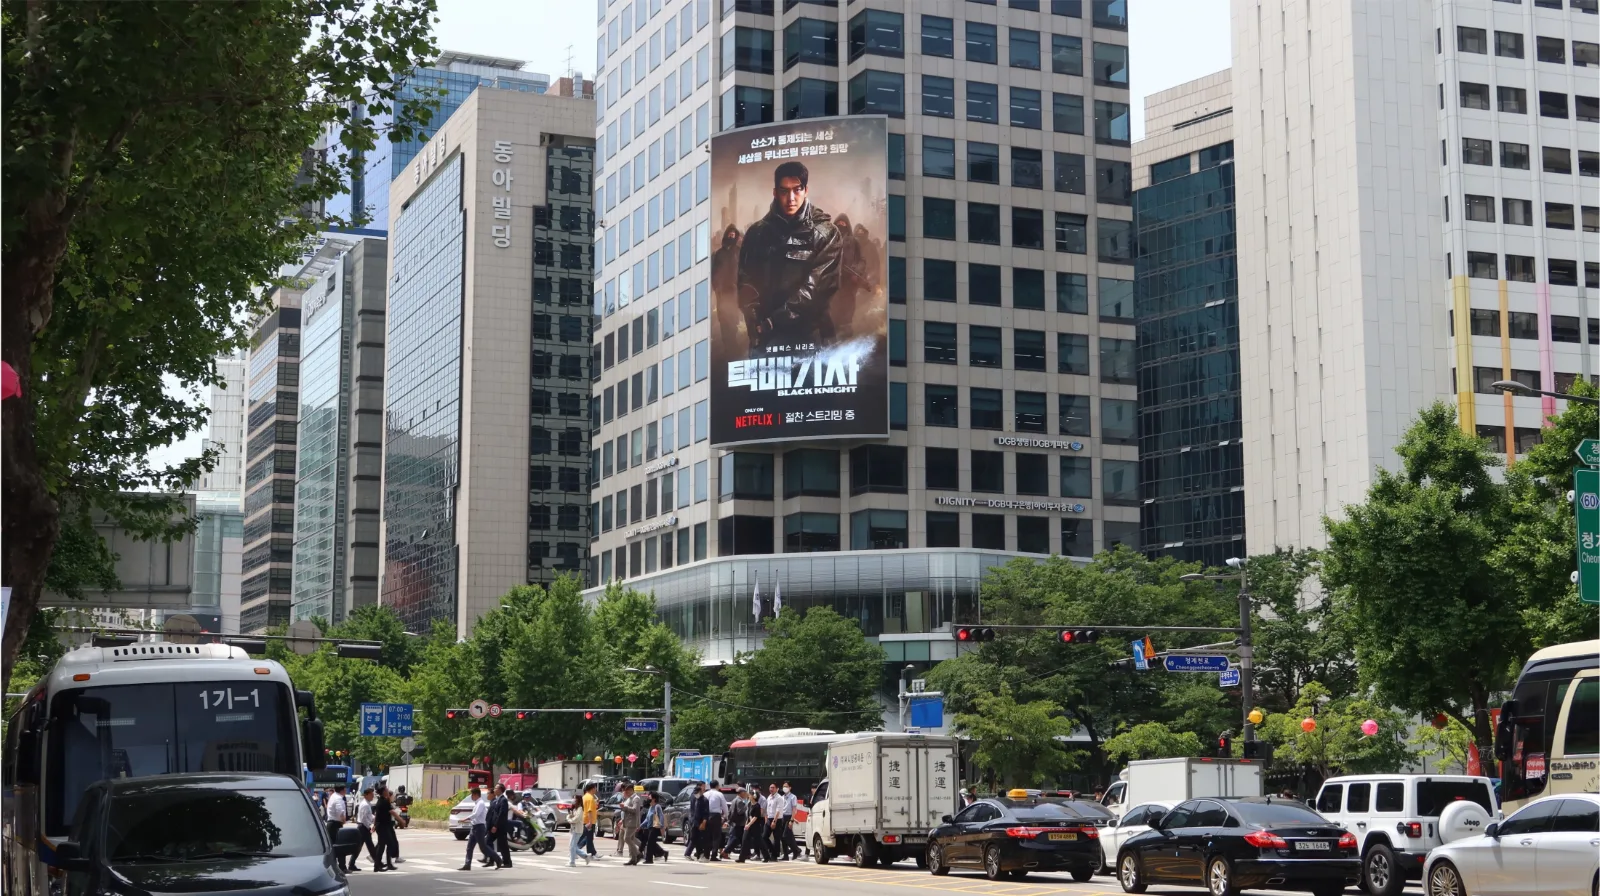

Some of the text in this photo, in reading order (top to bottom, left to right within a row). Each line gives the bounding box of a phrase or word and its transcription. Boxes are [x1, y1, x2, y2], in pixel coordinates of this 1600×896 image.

[751, 130, 834, 149] 산소가 통제되는 세상
[413, 131, 447, 184] 동아빌딩
[737, 143, 849, 164] 세상을 무너뜨릴 유일한 희망
[492, 140, 514, 248] 동아빌딩
[766, 343, 815, 353] 넷플릭스 시리즈
[727, 354, 860, 391] 택배기사
[777, 386, 858, 397] BLACK KNIGHT
[735, 409, 855, 428] NETFLIX 절찬 스트리밍 중
[938, 496, 977, 507] DIGNITY
[1584, 495, 1596, 508] 60
[1581, 531, 1599, 549] 청
[199, 687, 260, 710] 1기-1
[1463, 819, 1481, 827] Jeep
